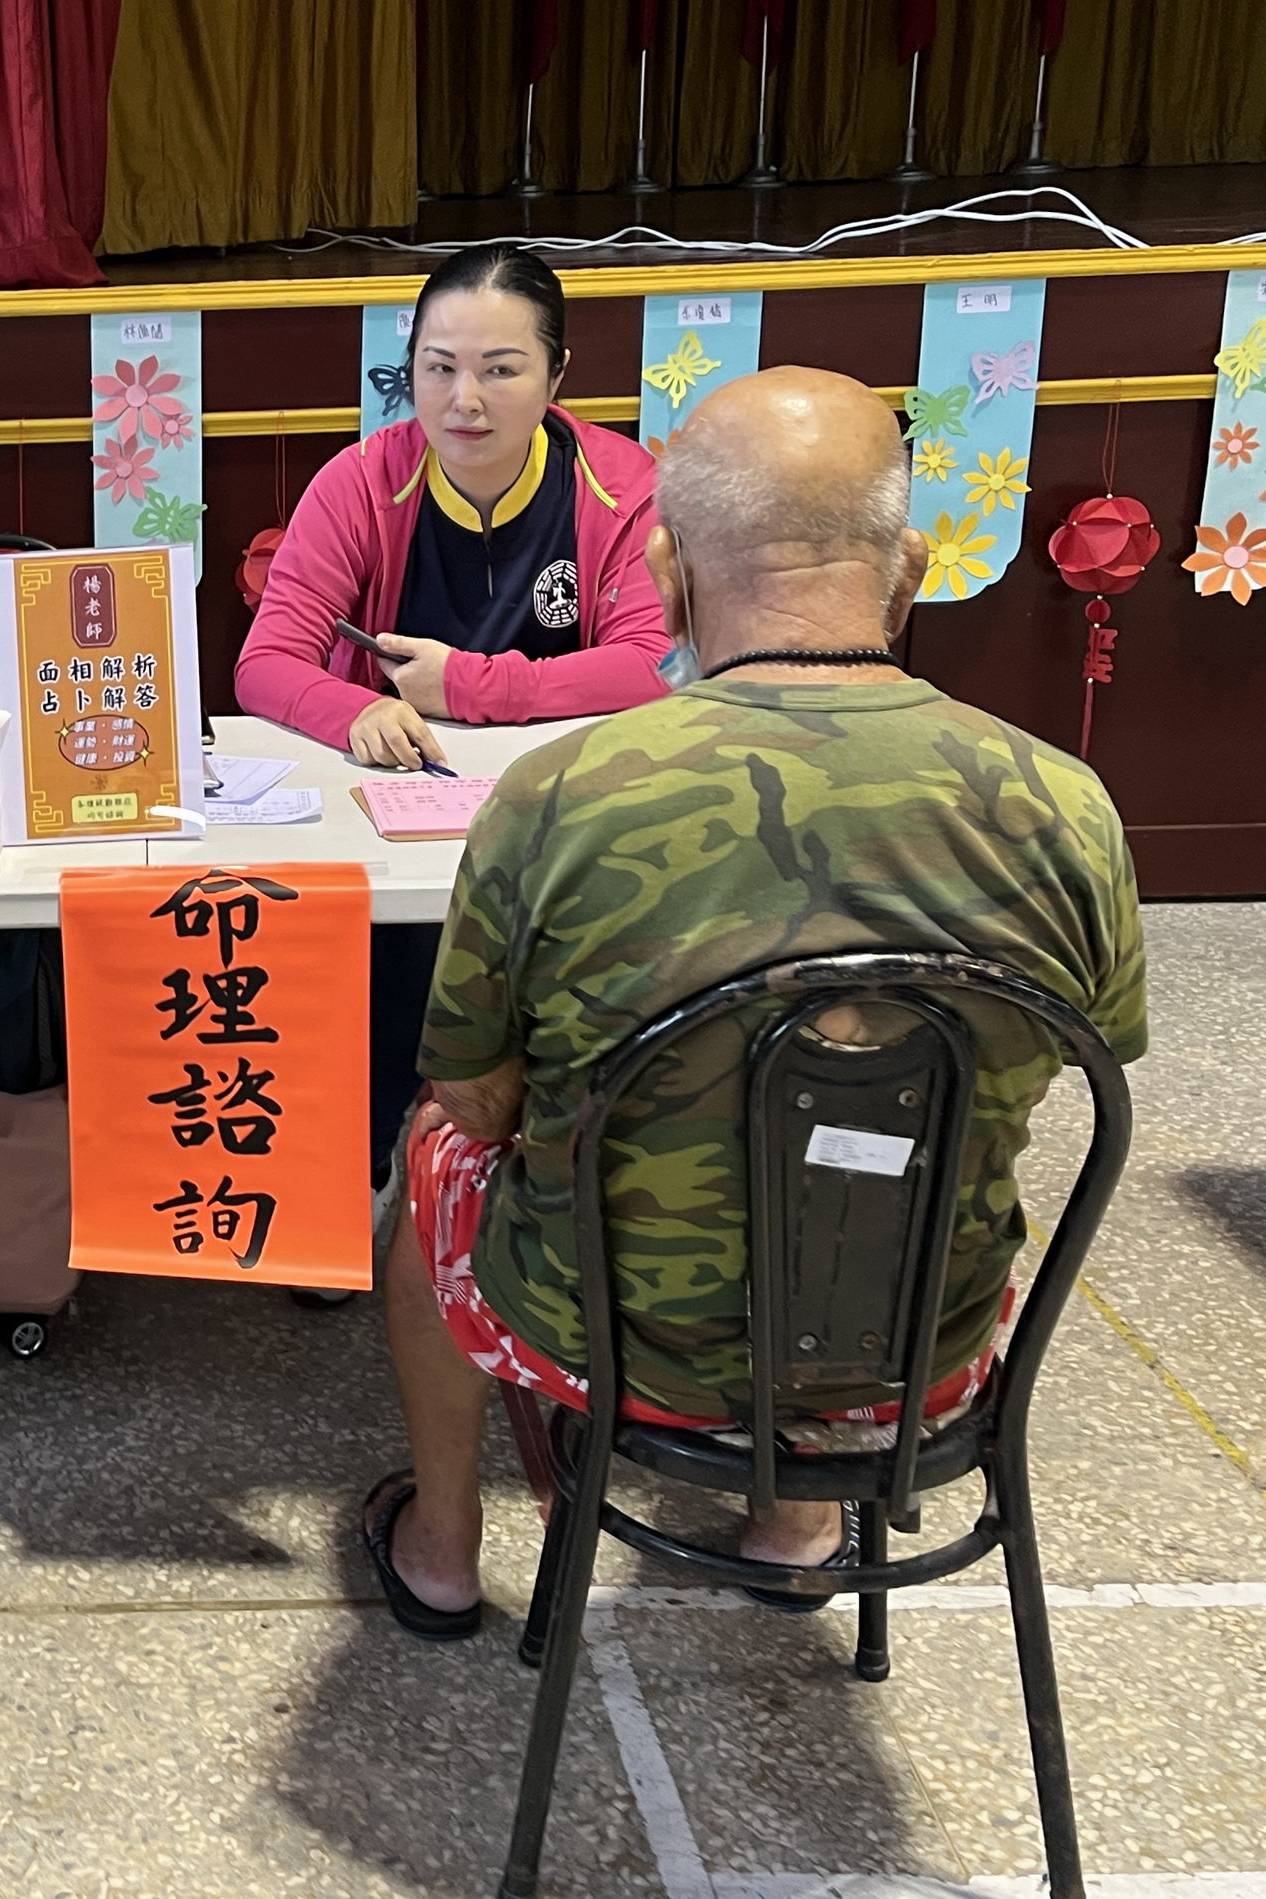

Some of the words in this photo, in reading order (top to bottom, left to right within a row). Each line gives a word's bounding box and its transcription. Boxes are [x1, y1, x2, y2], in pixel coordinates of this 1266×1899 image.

[83, 574, 103, 640] 楊老師
[38, 654, 156, 682] 面相解析
[41, 684, 158, 713] 占卜解答
[148, 869, 299, 1269] 命理諮詢
